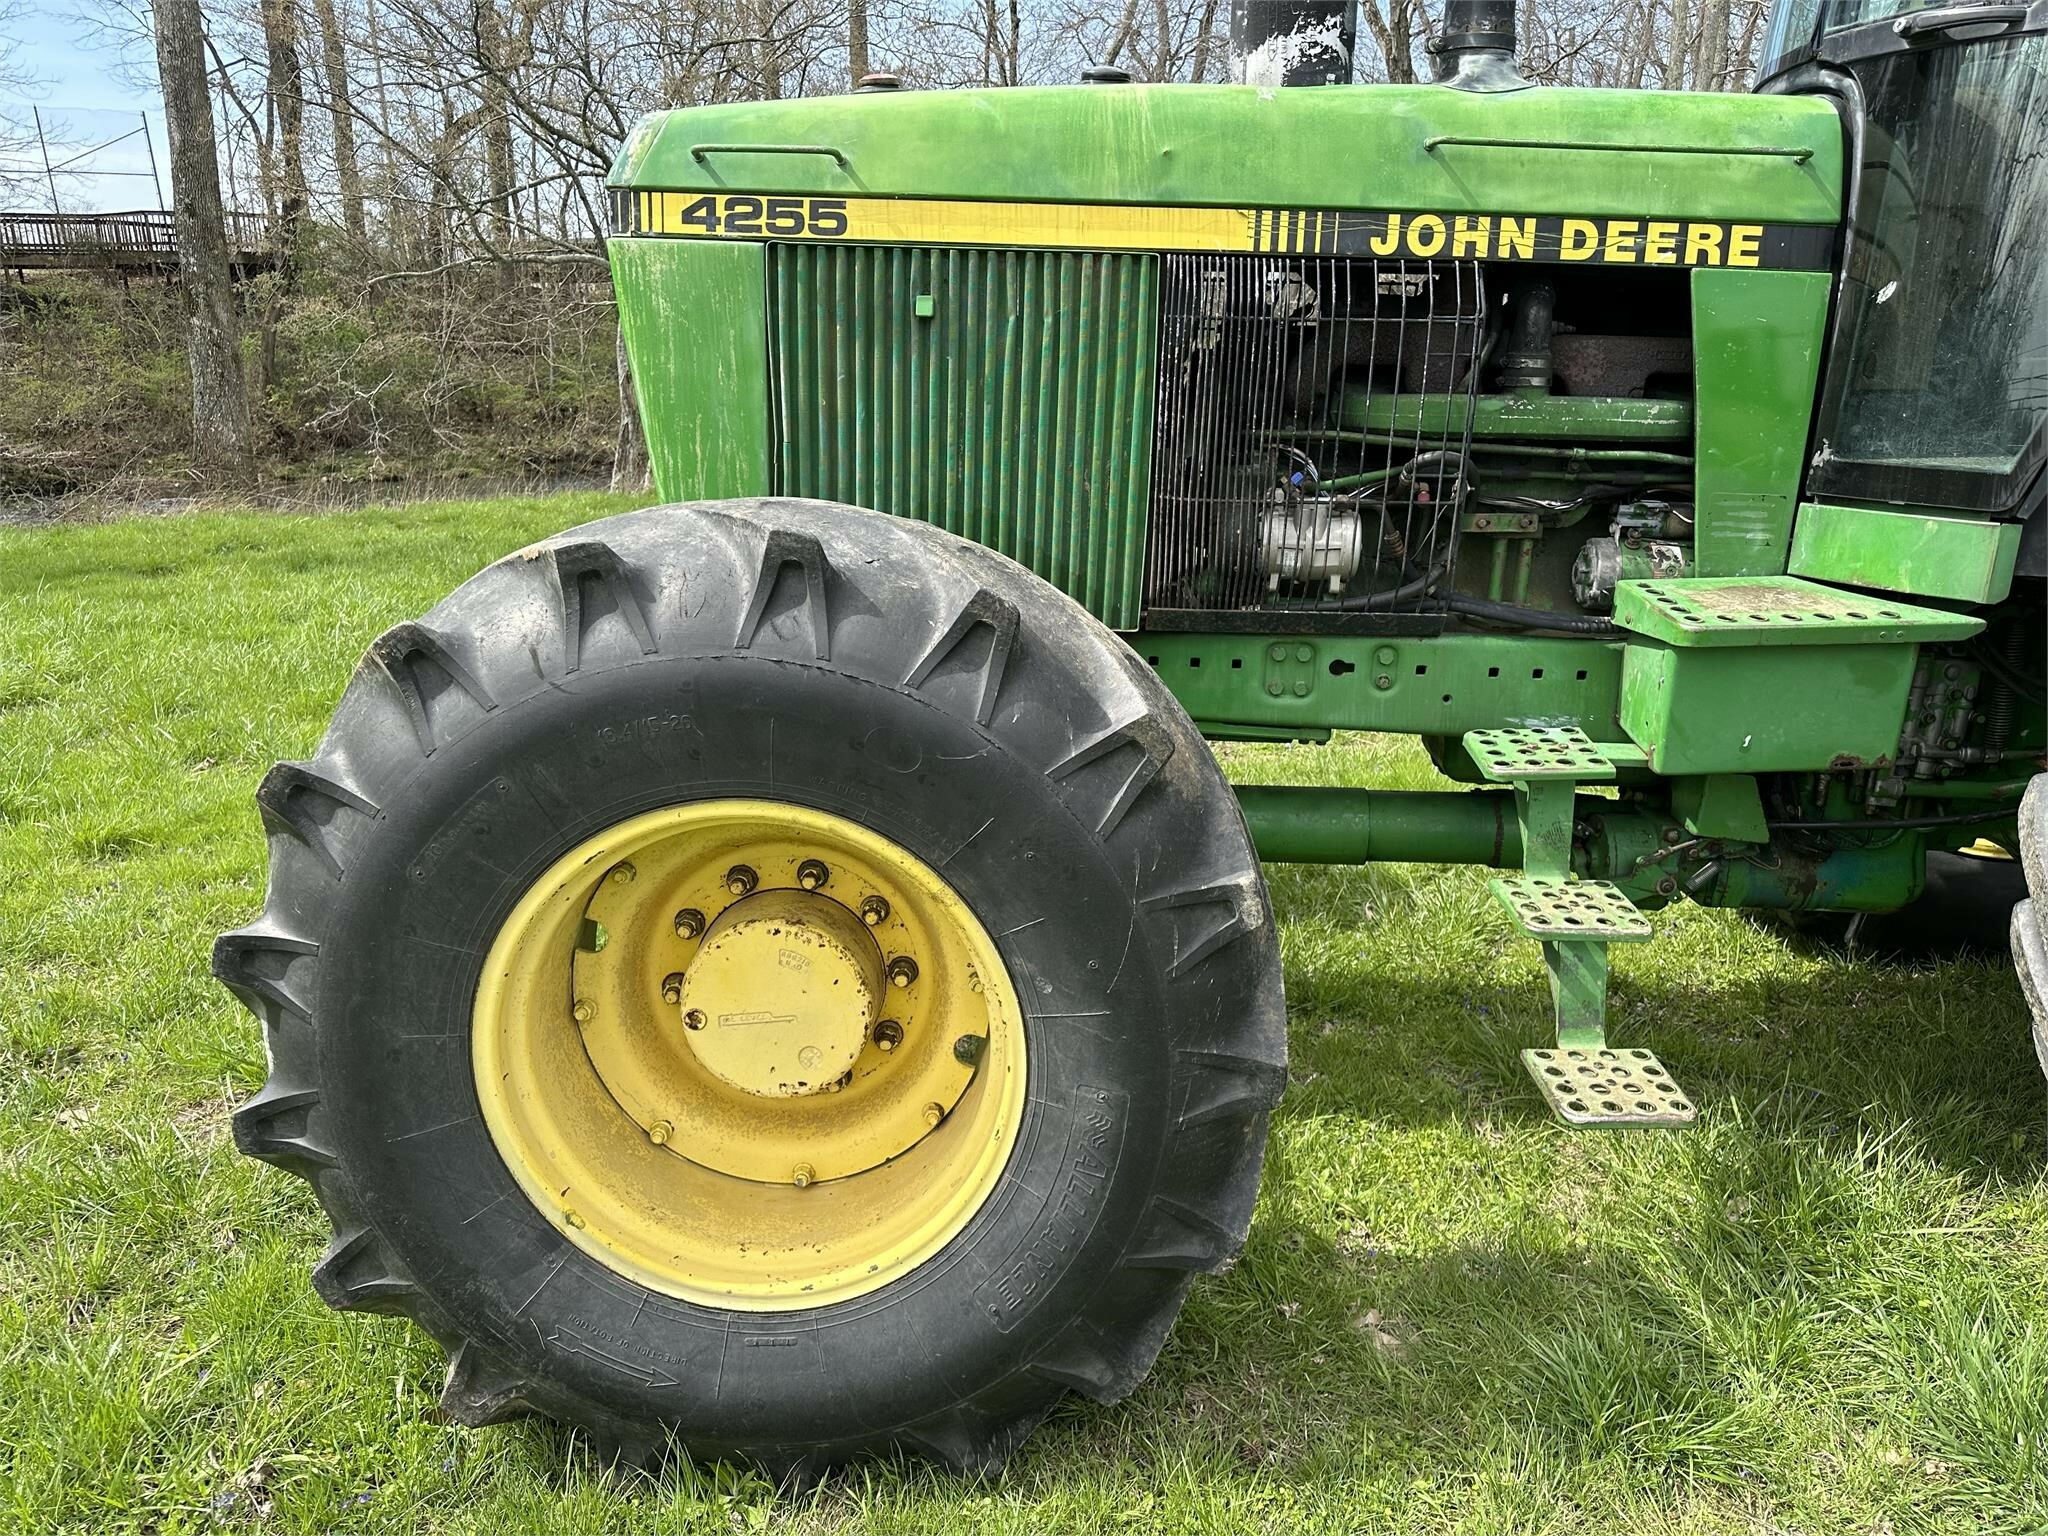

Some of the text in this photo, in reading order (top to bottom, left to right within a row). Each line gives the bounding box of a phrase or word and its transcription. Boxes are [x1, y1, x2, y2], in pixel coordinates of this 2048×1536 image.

[681, 196, 848, 236] 4255
[1370, 213, 1764, 267] JOHN DEERE
